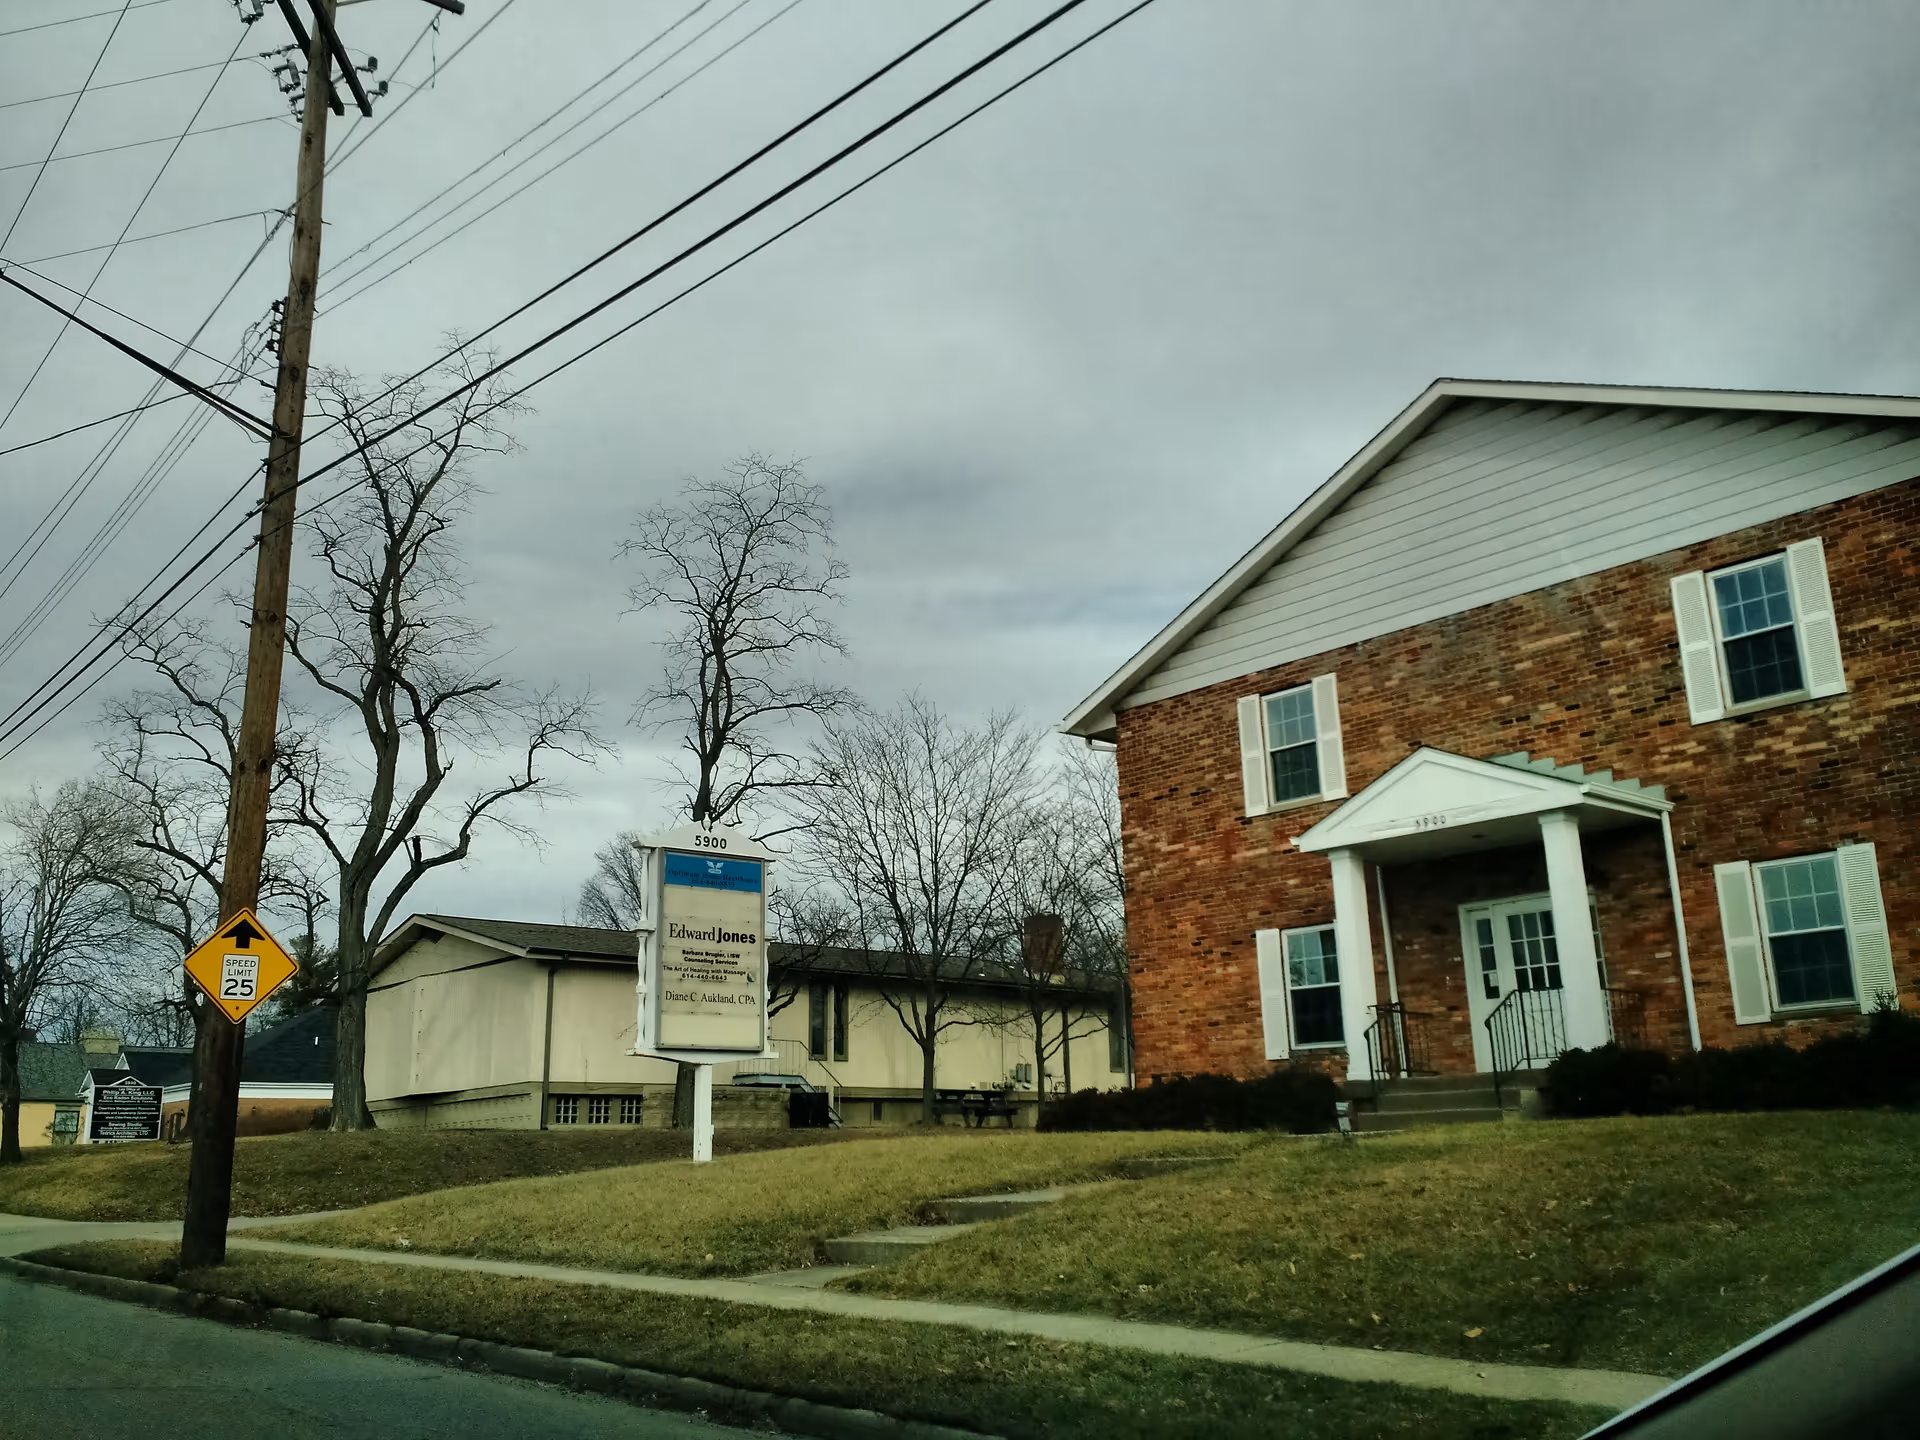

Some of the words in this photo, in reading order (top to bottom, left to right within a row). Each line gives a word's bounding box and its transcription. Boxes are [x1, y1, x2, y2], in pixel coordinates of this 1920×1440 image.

[695, 835, 727, 849] 5900
[669, 922, 715, 941] Edward
[716, 927, 756, 944] Jones
[225, 959, 256, 968] SPEED
[684, 956, 714, 965] Counseling
[228, 968, 252, 977] LIMIT
[723, 969, 746, 977] Massage
[224, 978, 254, 997] 25
[665, 990, 688, 1002] Diane
[690, 992, 699, 1002] C.
[700, 993, 736, 1004] Aukland,
[738, 994, 756, 1005] CPA
